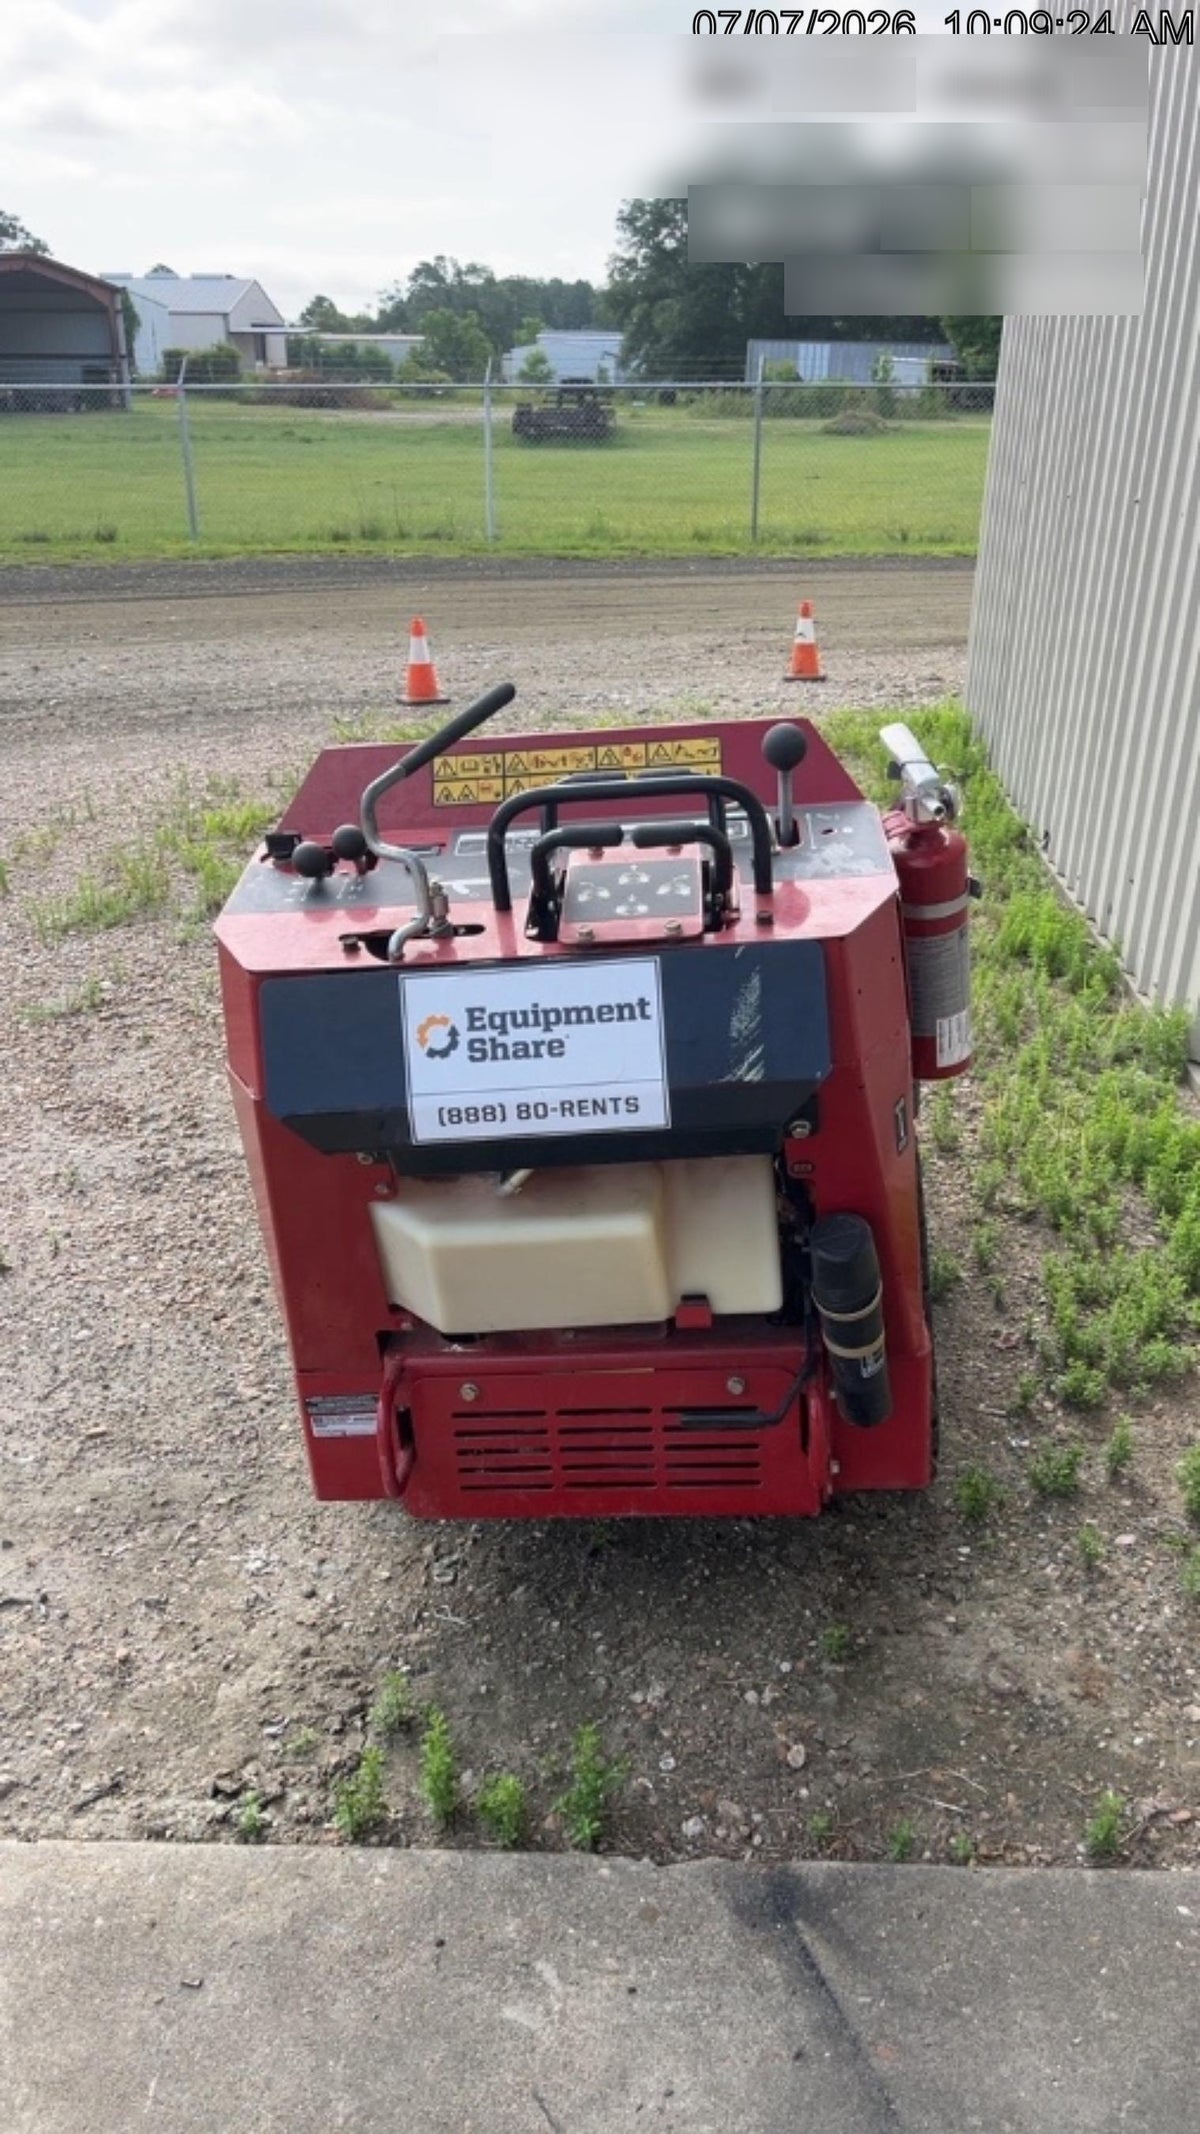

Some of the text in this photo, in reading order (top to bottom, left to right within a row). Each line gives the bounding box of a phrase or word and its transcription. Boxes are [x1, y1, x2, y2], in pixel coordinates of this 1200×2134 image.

[465, 998, 651, 1035] Equipment
[467, 1036, 566, 1063] Share
[438, 1096, 639, 1127] (888) 80-RENTS
